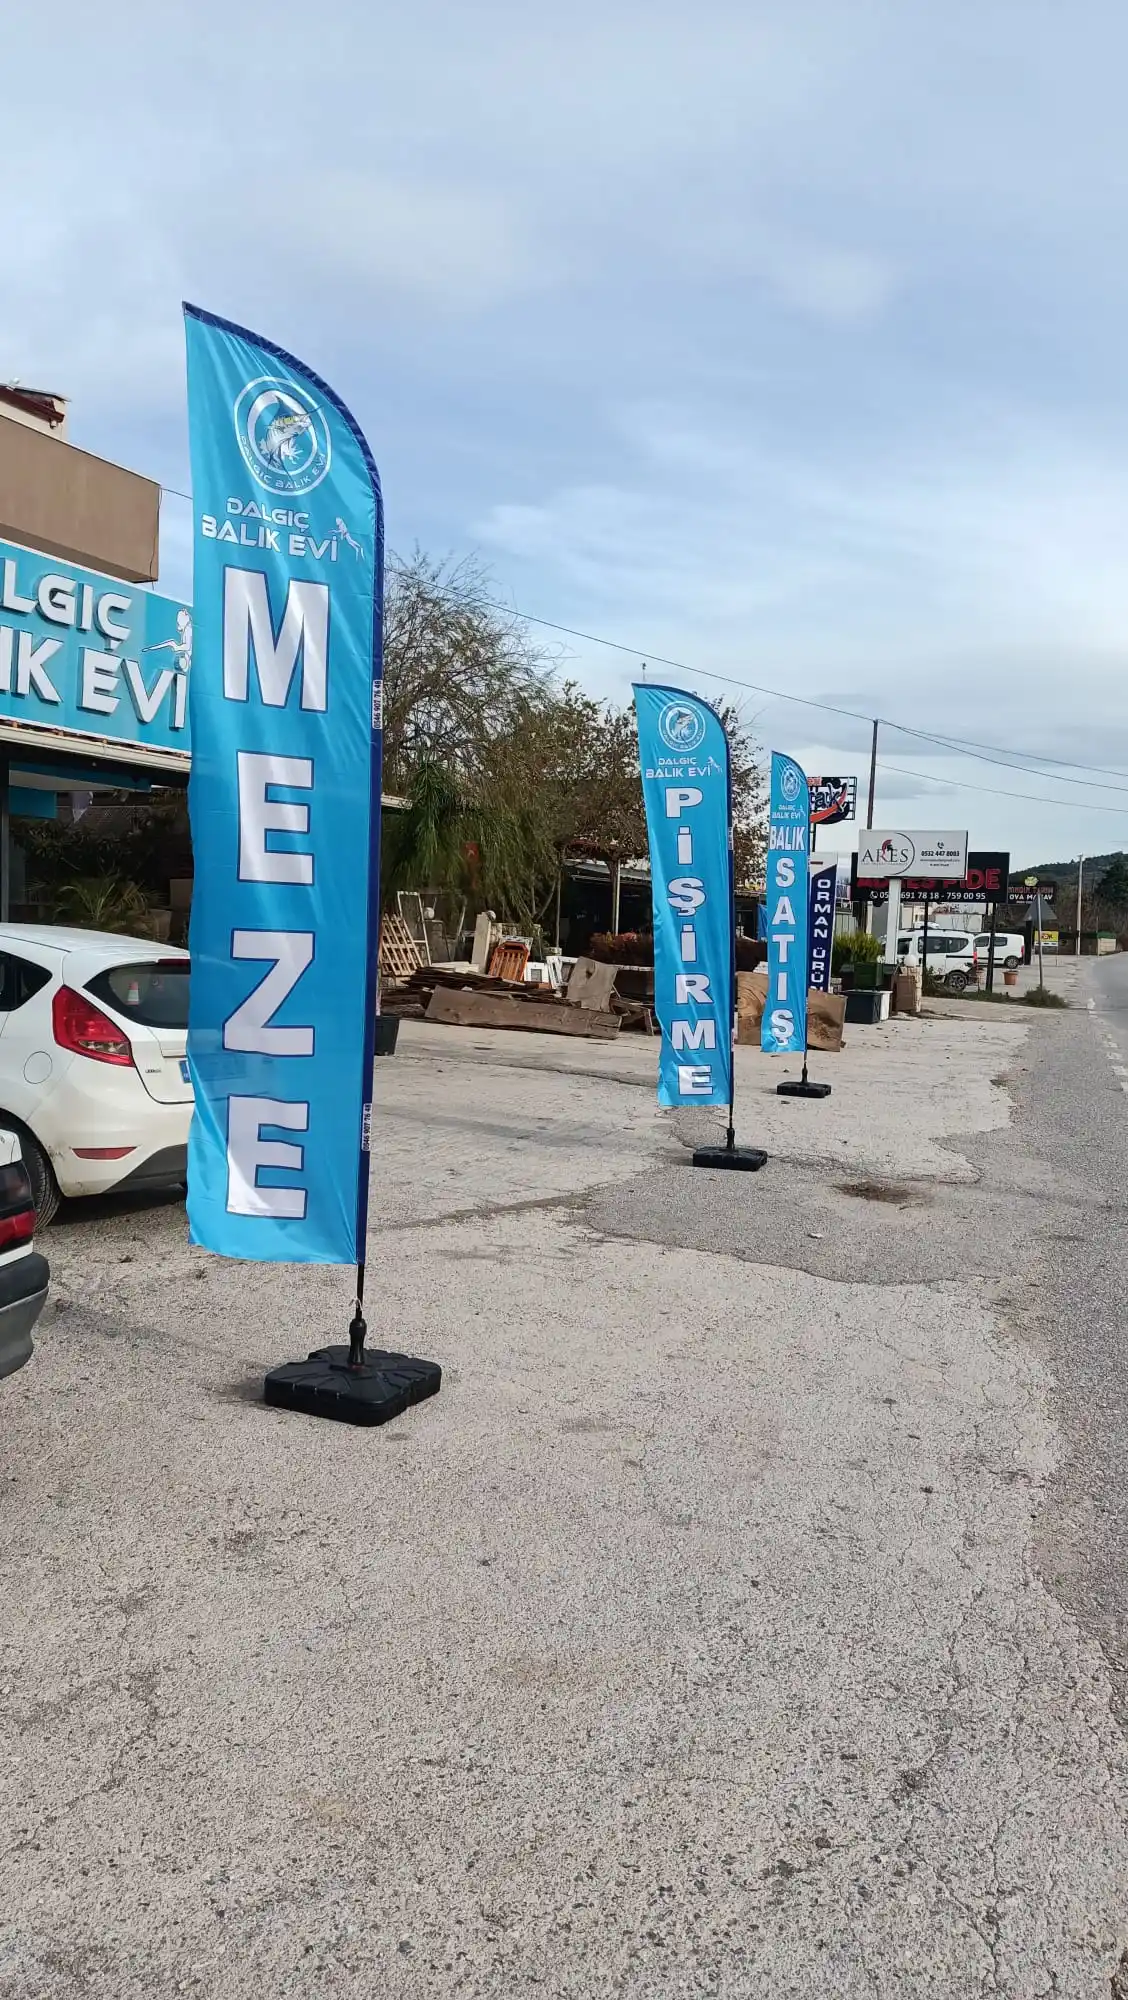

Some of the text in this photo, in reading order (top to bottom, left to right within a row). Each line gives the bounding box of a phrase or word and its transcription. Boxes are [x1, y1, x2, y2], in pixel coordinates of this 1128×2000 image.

[275, 475, 312, 489] BALIK
[226, 497, 310, 532] DALGIÇ
[202, 514, 338, 562] BALIK EVİ
[373, 700, 382, 711] 907
[373, 713, 382, 729] 0546
[645, 764, 711, 778] BALIK EVİ
[658, 757, 697, 767] DALGIÇ
[769, 825, 806, 851] BALIK
[862, 848, 909, 863] ARES
[223, 566, 331, 1221] MEZE
[918, 891, 928, 899] 78
[931, 891, 940, 899] 18
[975, 892, 986, 900] 95
[813, 879, 831, 939] ORMAN
[665, 787, 716, 1096] PİŞİRME
[771, 857, 796, 1047] SATIŞ
